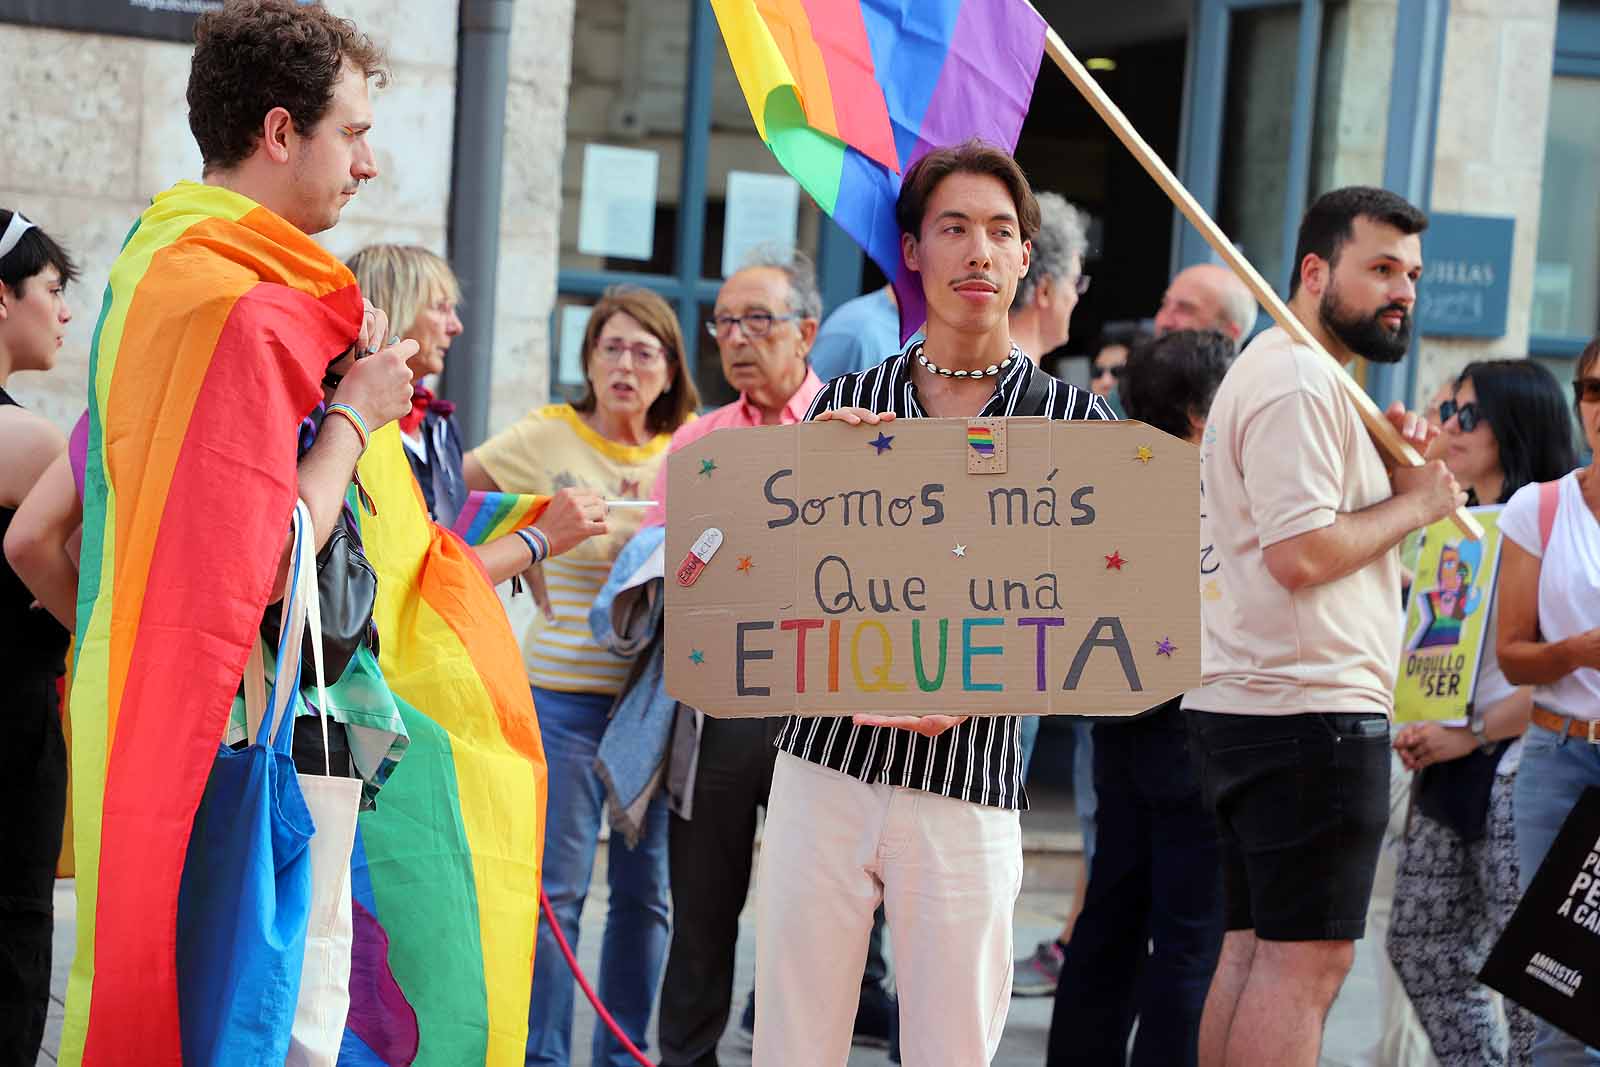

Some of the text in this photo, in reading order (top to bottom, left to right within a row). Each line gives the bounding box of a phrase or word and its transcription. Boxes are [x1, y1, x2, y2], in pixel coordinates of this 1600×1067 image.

[764, 468, 1096, 528] Somos más
[814, 555, 1063, 614] Que una
[736, 617, 1143, 696] ETIQUETA
[1425, 673, 1460, 697] SER
[1556, 897, 1573, 917] A
[1568, 871, 1600, 910] PE
